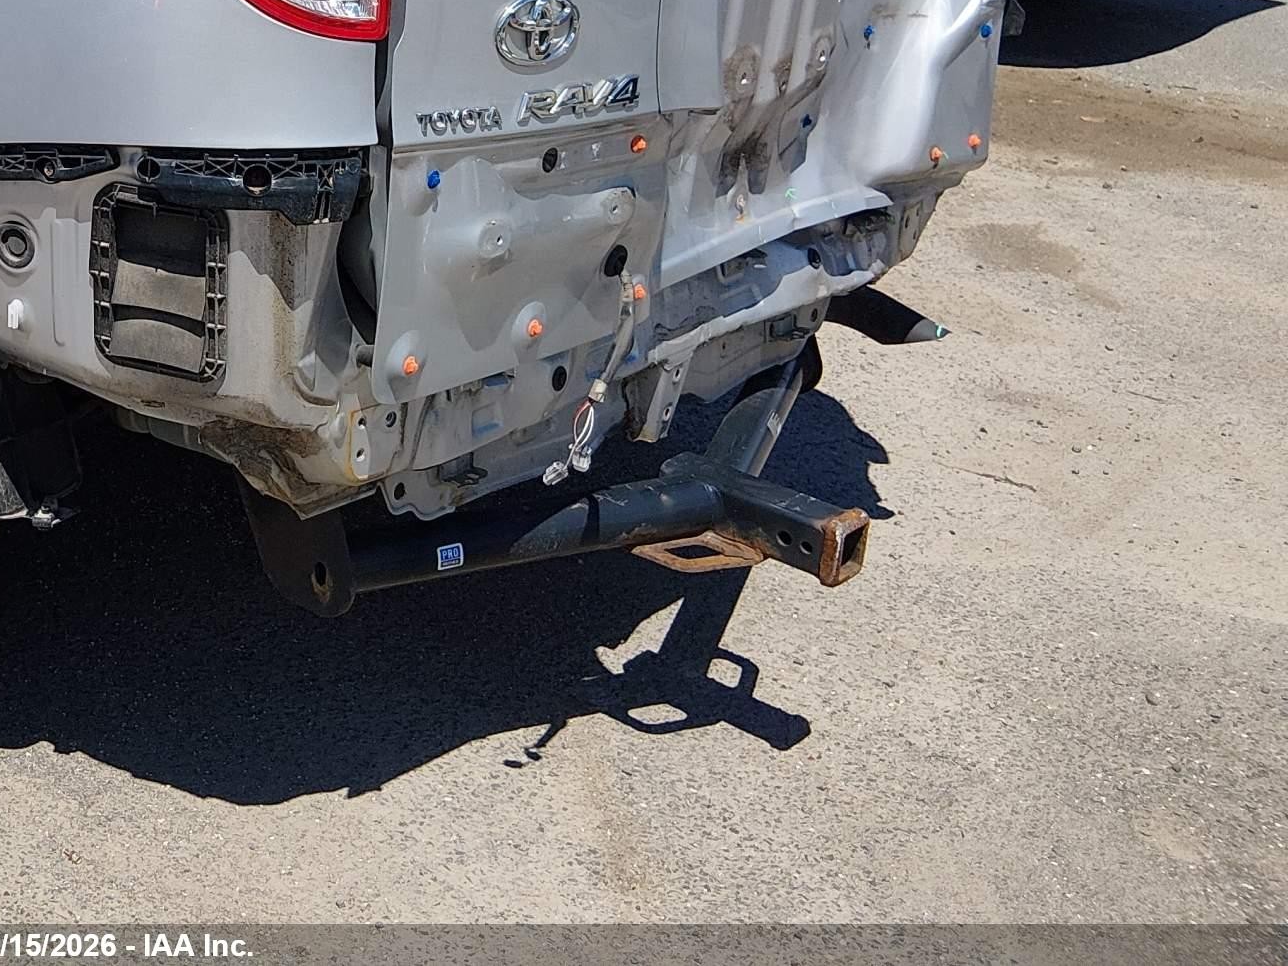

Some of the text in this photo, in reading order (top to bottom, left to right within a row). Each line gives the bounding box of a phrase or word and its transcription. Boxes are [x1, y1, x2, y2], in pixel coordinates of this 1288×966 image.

[517, 74, 640, 127] RAV4
[416, 106, 503, 137] TOYOTA
[442, 547, 459, 561] PRO
